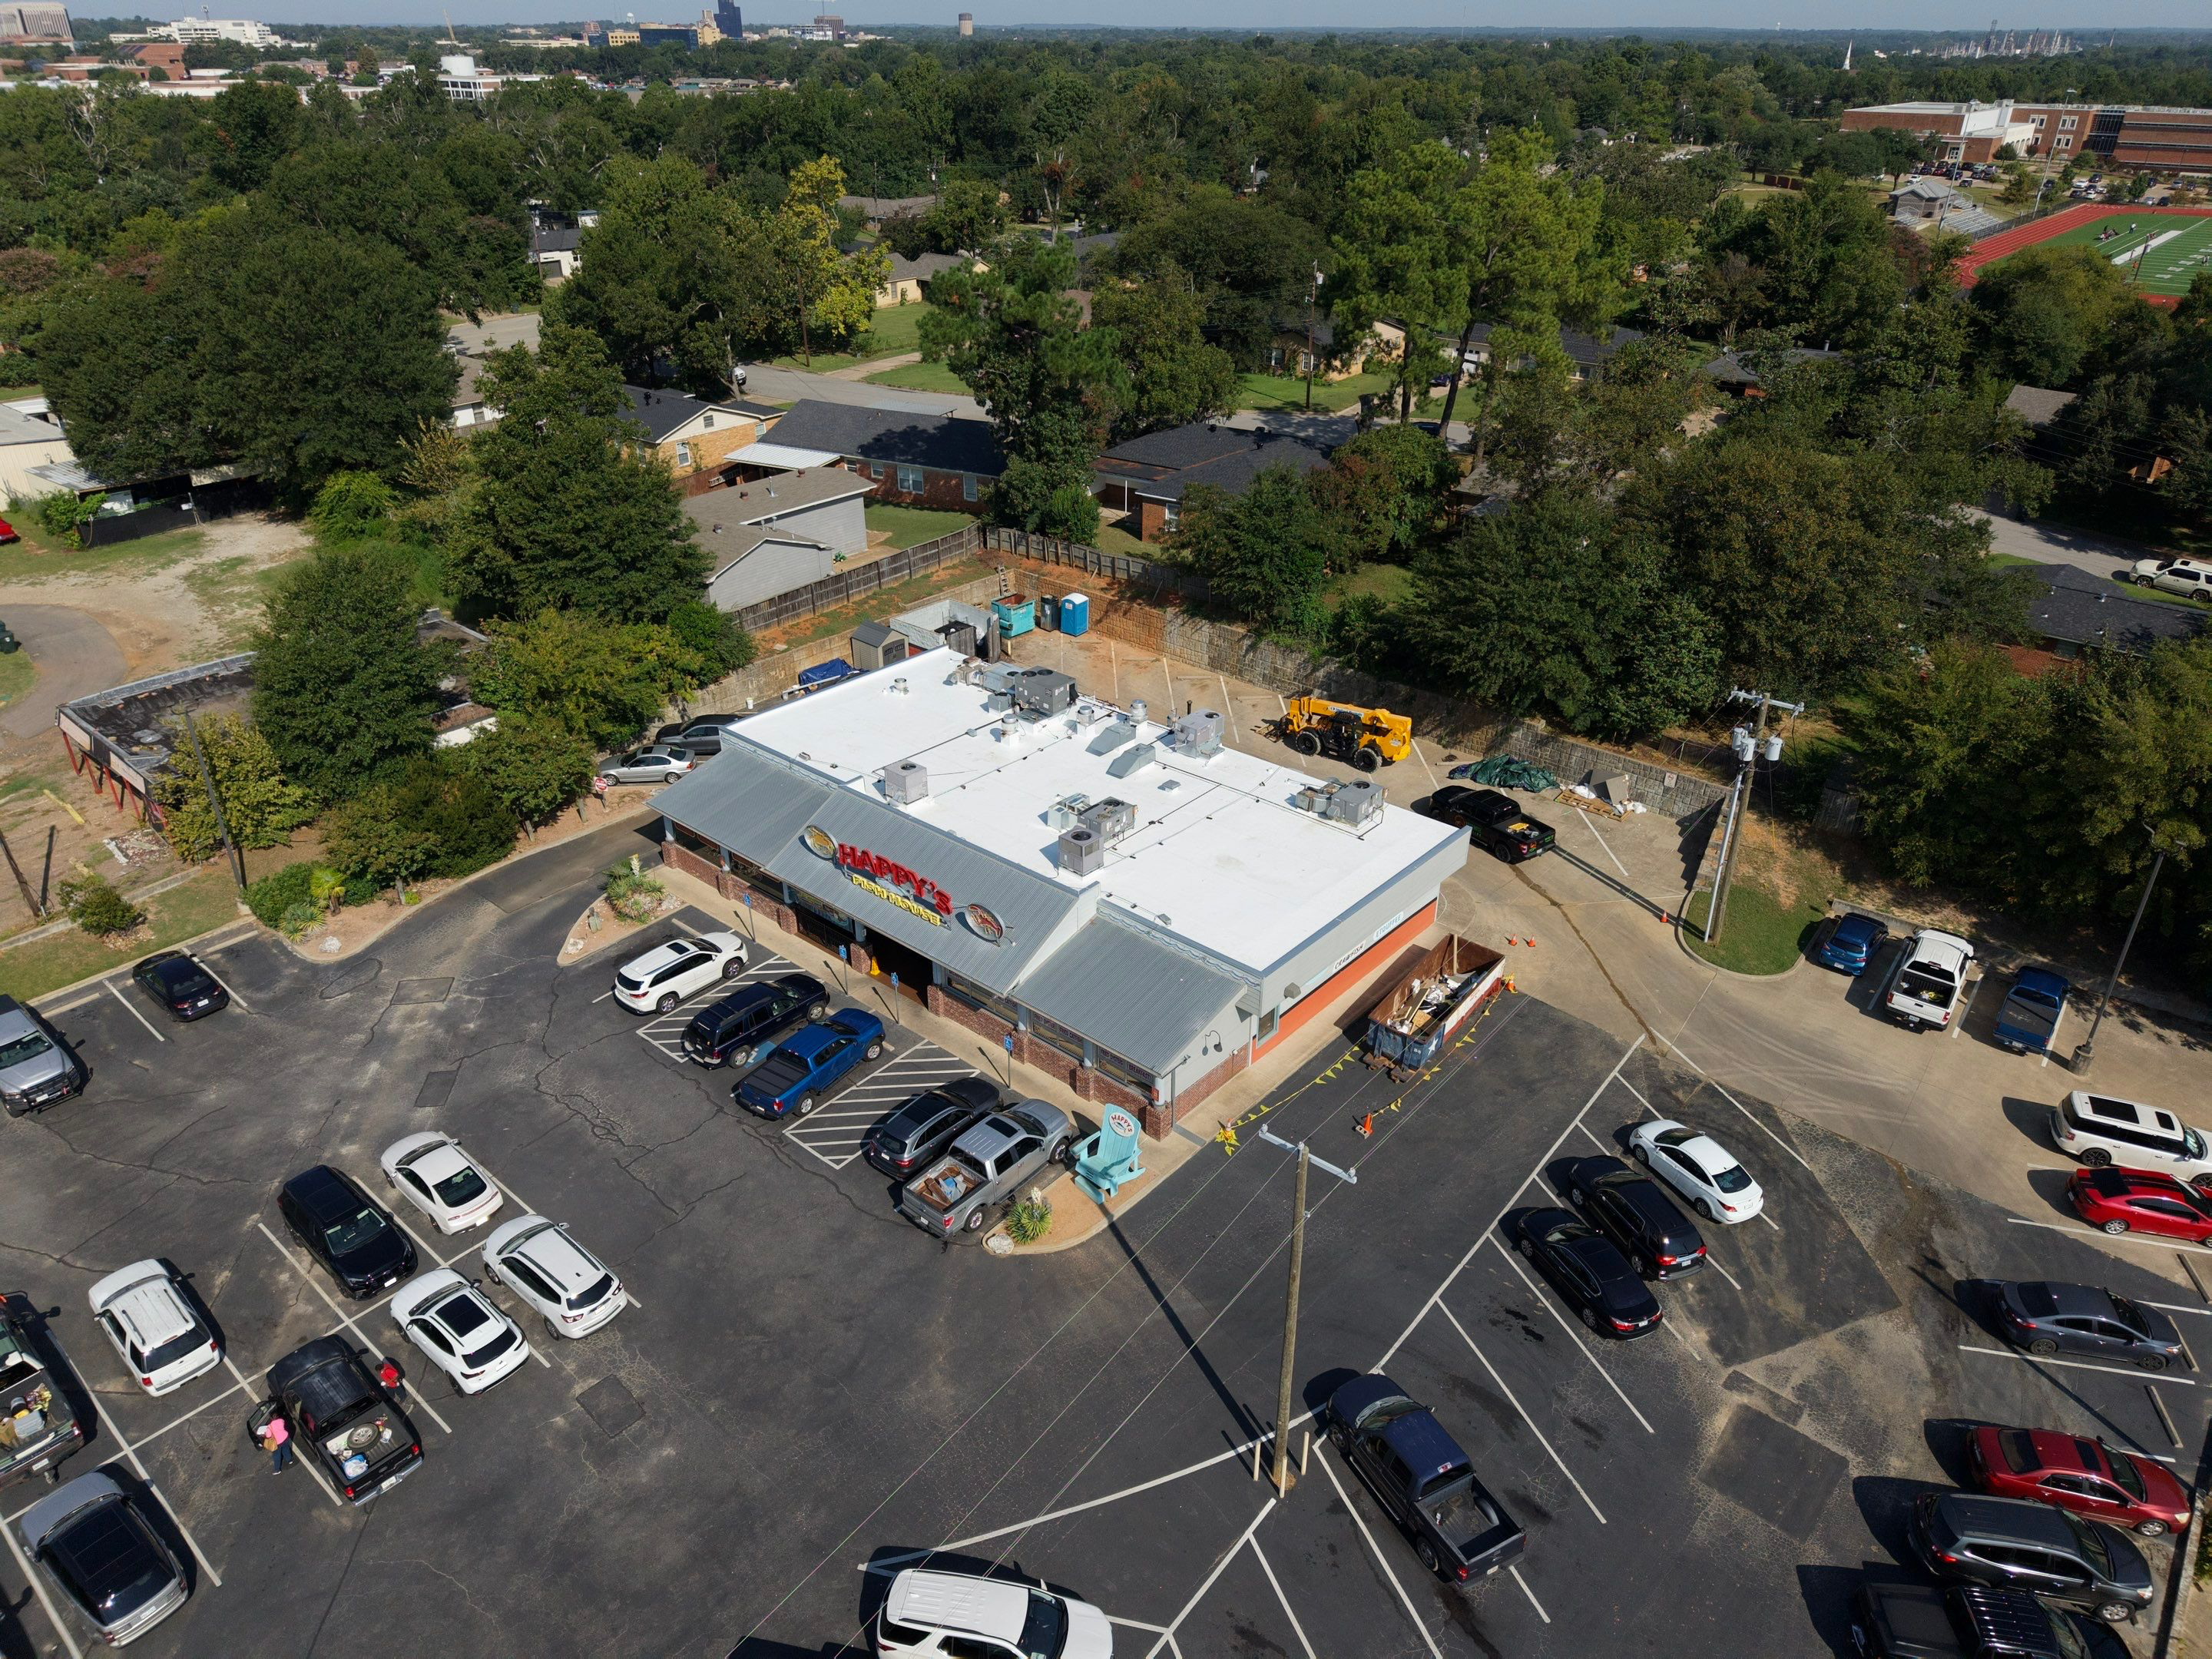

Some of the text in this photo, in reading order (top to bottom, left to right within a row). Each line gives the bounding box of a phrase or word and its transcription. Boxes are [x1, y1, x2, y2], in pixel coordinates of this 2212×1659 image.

[838, 843, 953, 915] HAPPY'S
[853, 874, 941, 926] FISH HOUSE
[1334, 942, 1363, 969] CRAWFISH
[1111, 1114, 1132, 1132] HAPPYS
